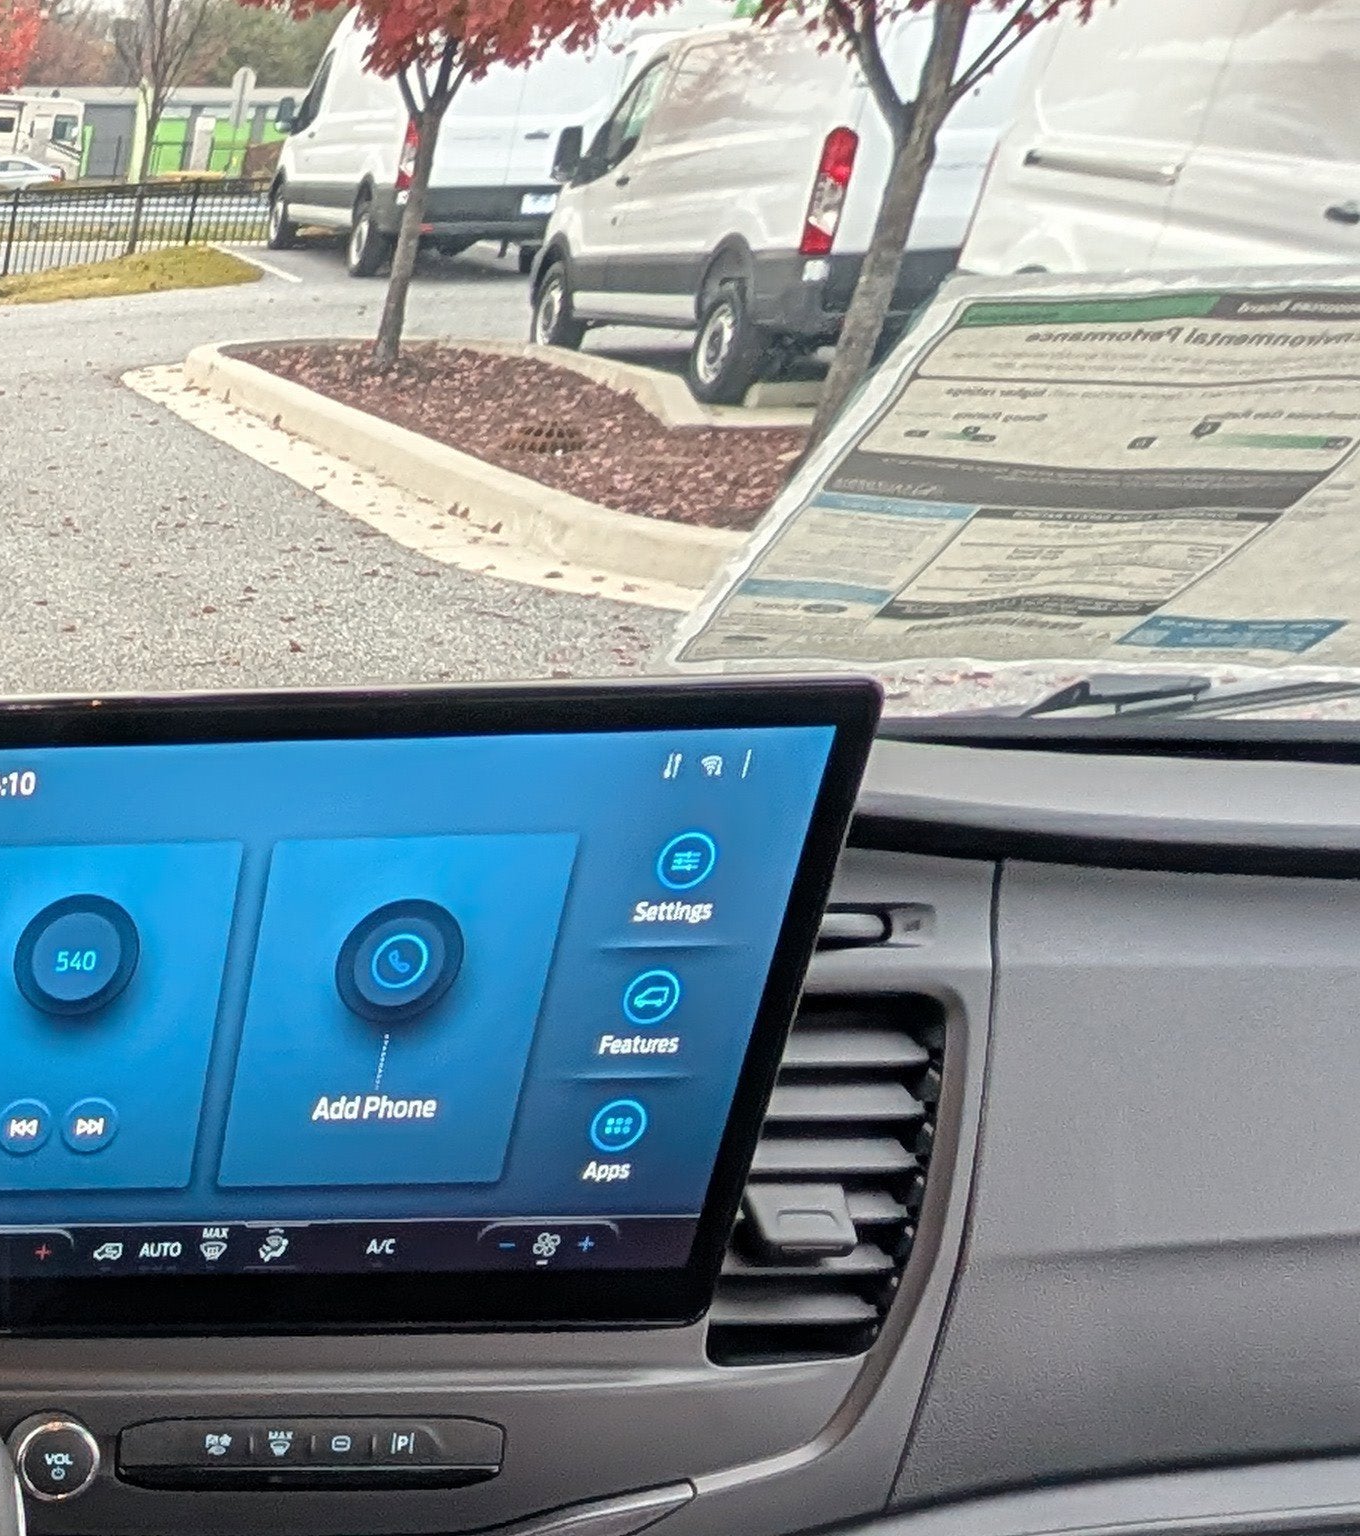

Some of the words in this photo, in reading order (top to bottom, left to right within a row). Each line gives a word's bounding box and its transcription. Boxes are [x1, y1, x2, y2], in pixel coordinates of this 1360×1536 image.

[631, 900, 714, 924] Settings
[55, 950, 97, 972] 540
[598, 1034, 680, 1055] Features
[311, 1095, 362, 1121] Add
[363, 1095, 438, 1119] Phone
[582, 1160, 631, 1182] Apps
[202, 1227, 229, 1240] MAX
[138, 1241, 182, 1258] AUTO
[366, 1238, 397, 1255] A/C
[44, 1453, 74, 1466] VOL
